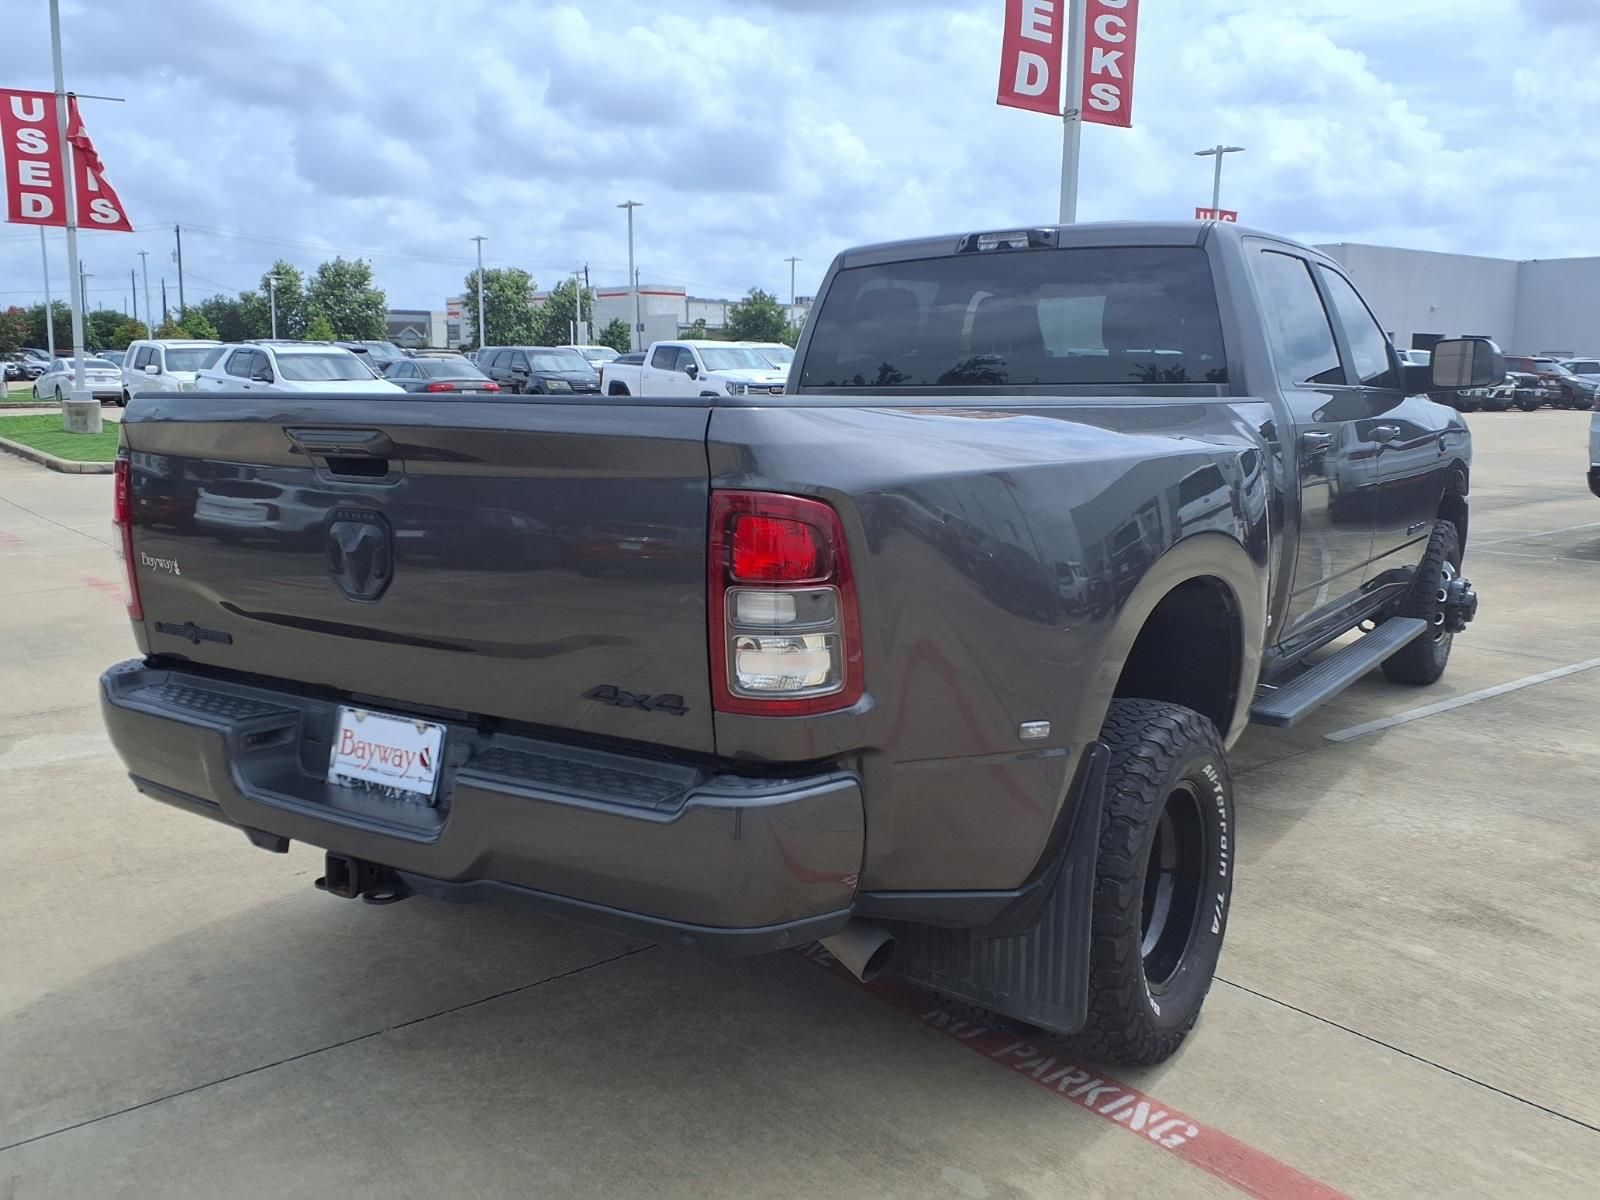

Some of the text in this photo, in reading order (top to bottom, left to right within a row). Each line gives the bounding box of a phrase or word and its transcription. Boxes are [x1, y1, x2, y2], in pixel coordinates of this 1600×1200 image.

[10, 95, 55, 219] USED
[141, 551, 176, 574] Bayway
[339, 728, 417, 779] Bayway
[999, 1039, 1199, 1150] PARKING
